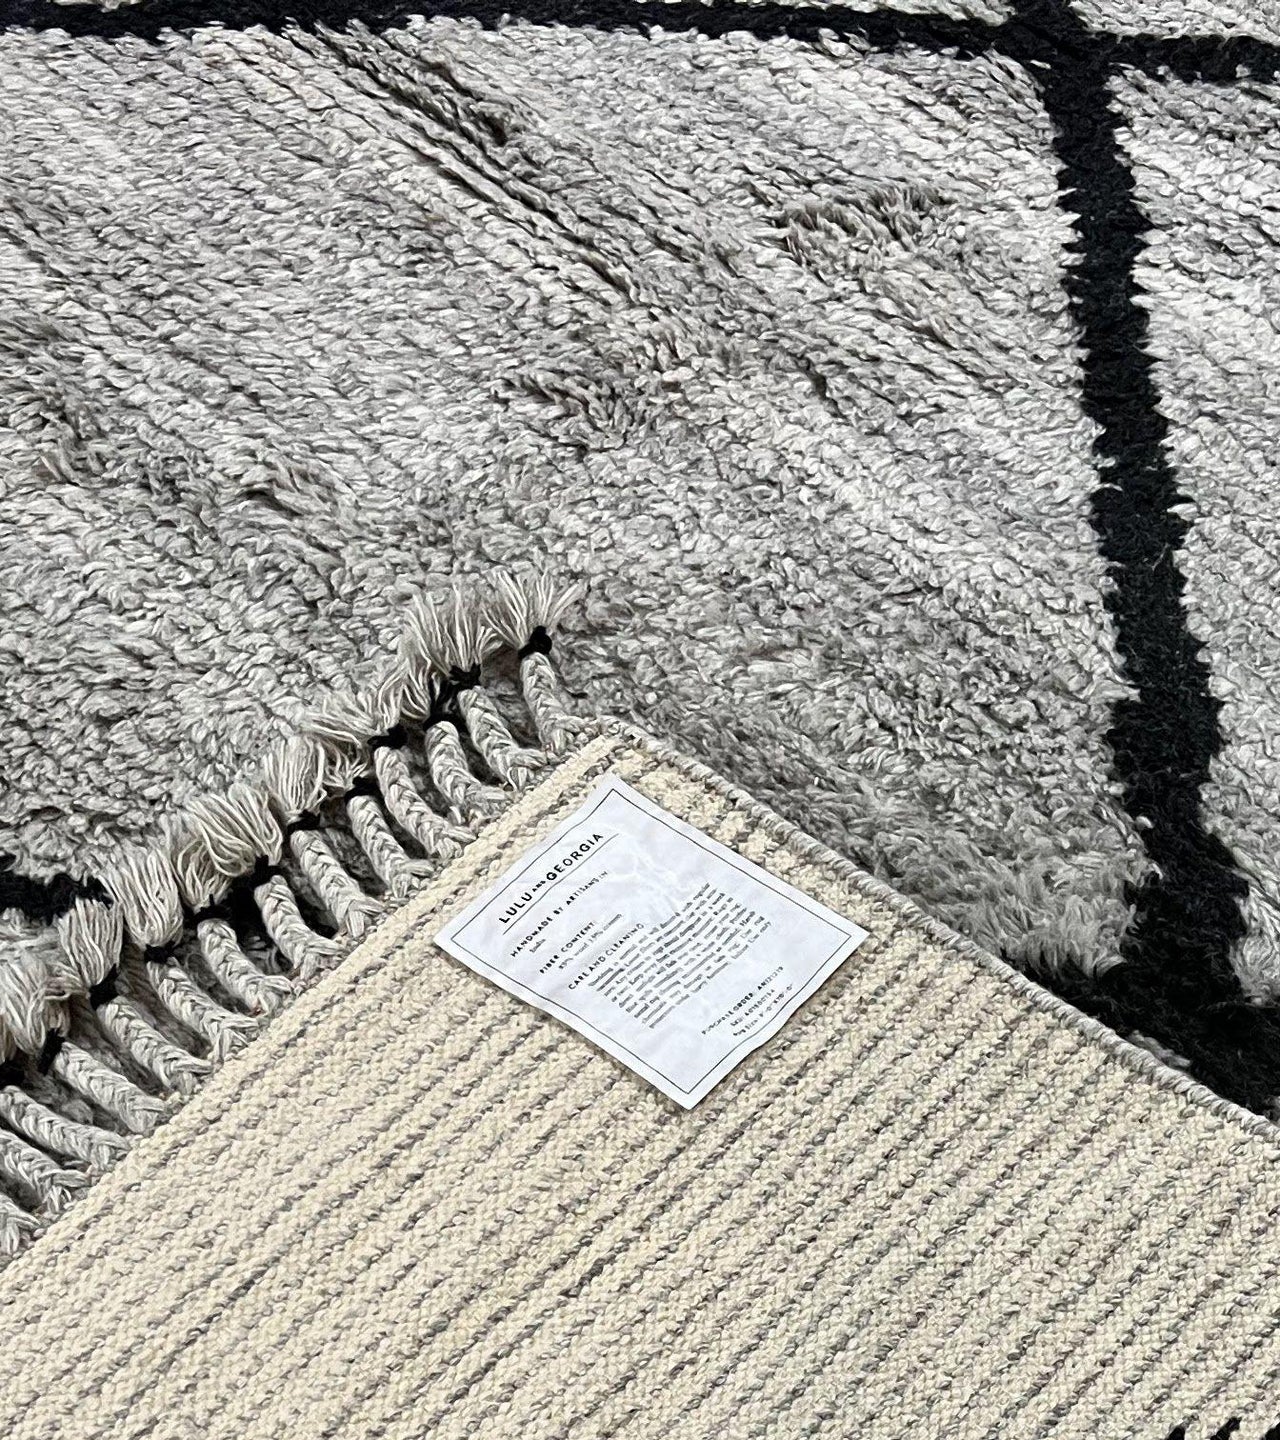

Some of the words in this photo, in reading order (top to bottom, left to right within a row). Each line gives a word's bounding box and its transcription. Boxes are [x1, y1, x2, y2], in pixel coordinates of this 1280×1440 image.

[499, 892, 532, 923] LULU
[545, 833, 602, 880] GEORGIA
[510, 916, 552, 956] HANDMADE
[569, 971, 588, 989] CARE
[587, 955, 606, 971] AND
[605, 923, 643, 955] CLEANING
